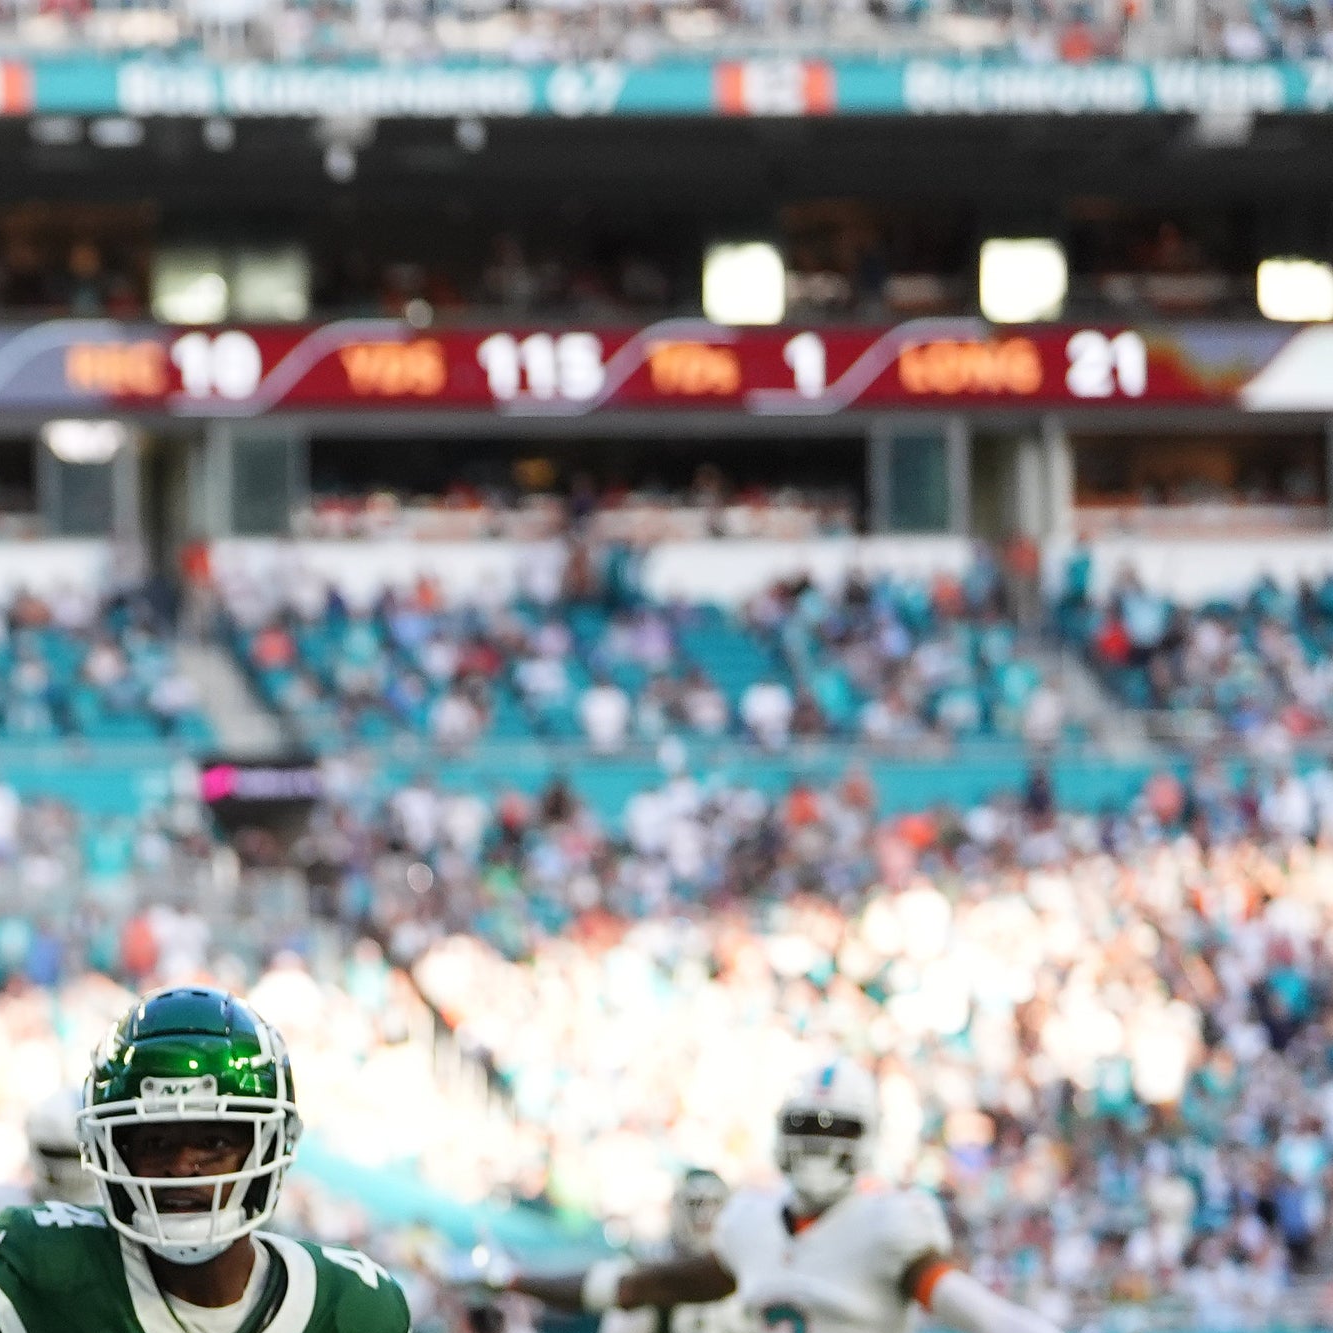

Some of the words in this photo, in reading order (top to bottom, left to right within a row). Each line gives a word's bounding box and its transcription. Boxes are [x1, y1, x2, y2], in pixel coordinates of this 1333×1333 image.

[172, 331, 262, 400] 10
[477, 331, 605, 401] 115
[783, 331, 826, 400] 1
[1065, 330, 1148, 399] 21
